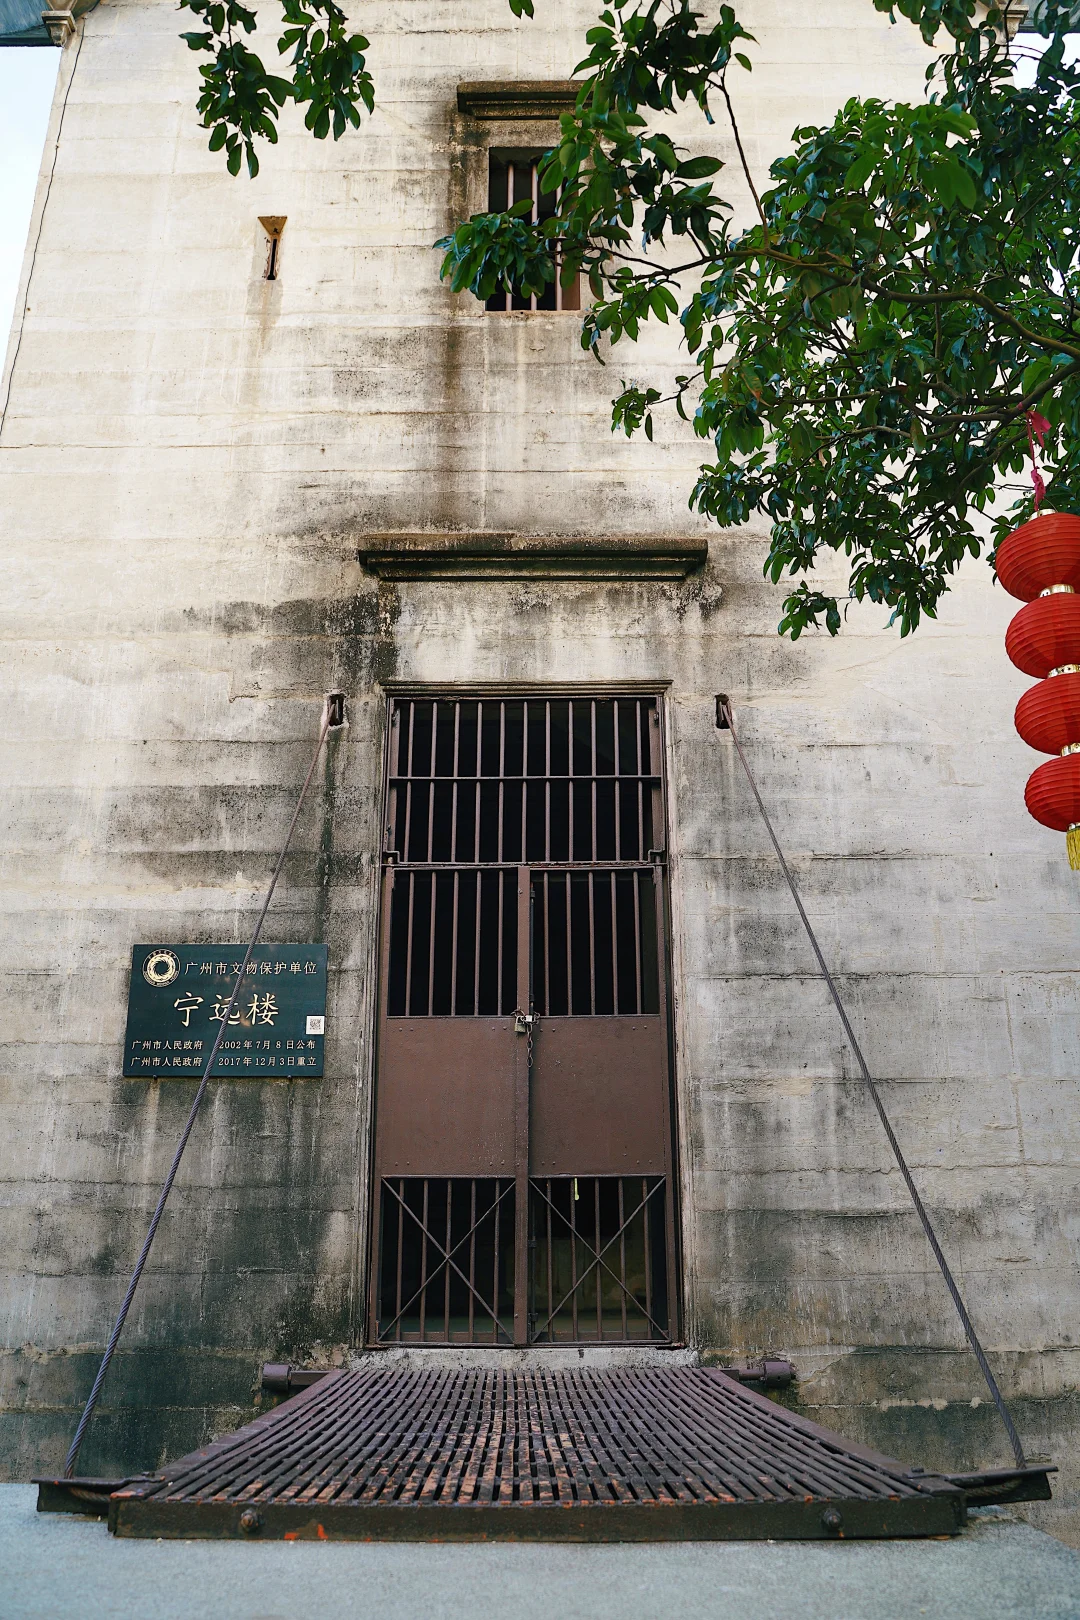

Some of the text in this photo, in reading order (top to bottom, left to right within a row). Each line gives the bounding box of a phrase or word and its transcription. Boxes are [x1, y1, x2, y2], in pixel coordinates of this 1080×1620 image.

[184, 961, 317, 975] 广州市文物保护单位
[173, 991, 279, 1027] 宁远楼
[131, 1040, 316, 1050] 广州市人民政府 2002年7月8日公布
[130, 1057, 203, 1067] 广州市人民政府
